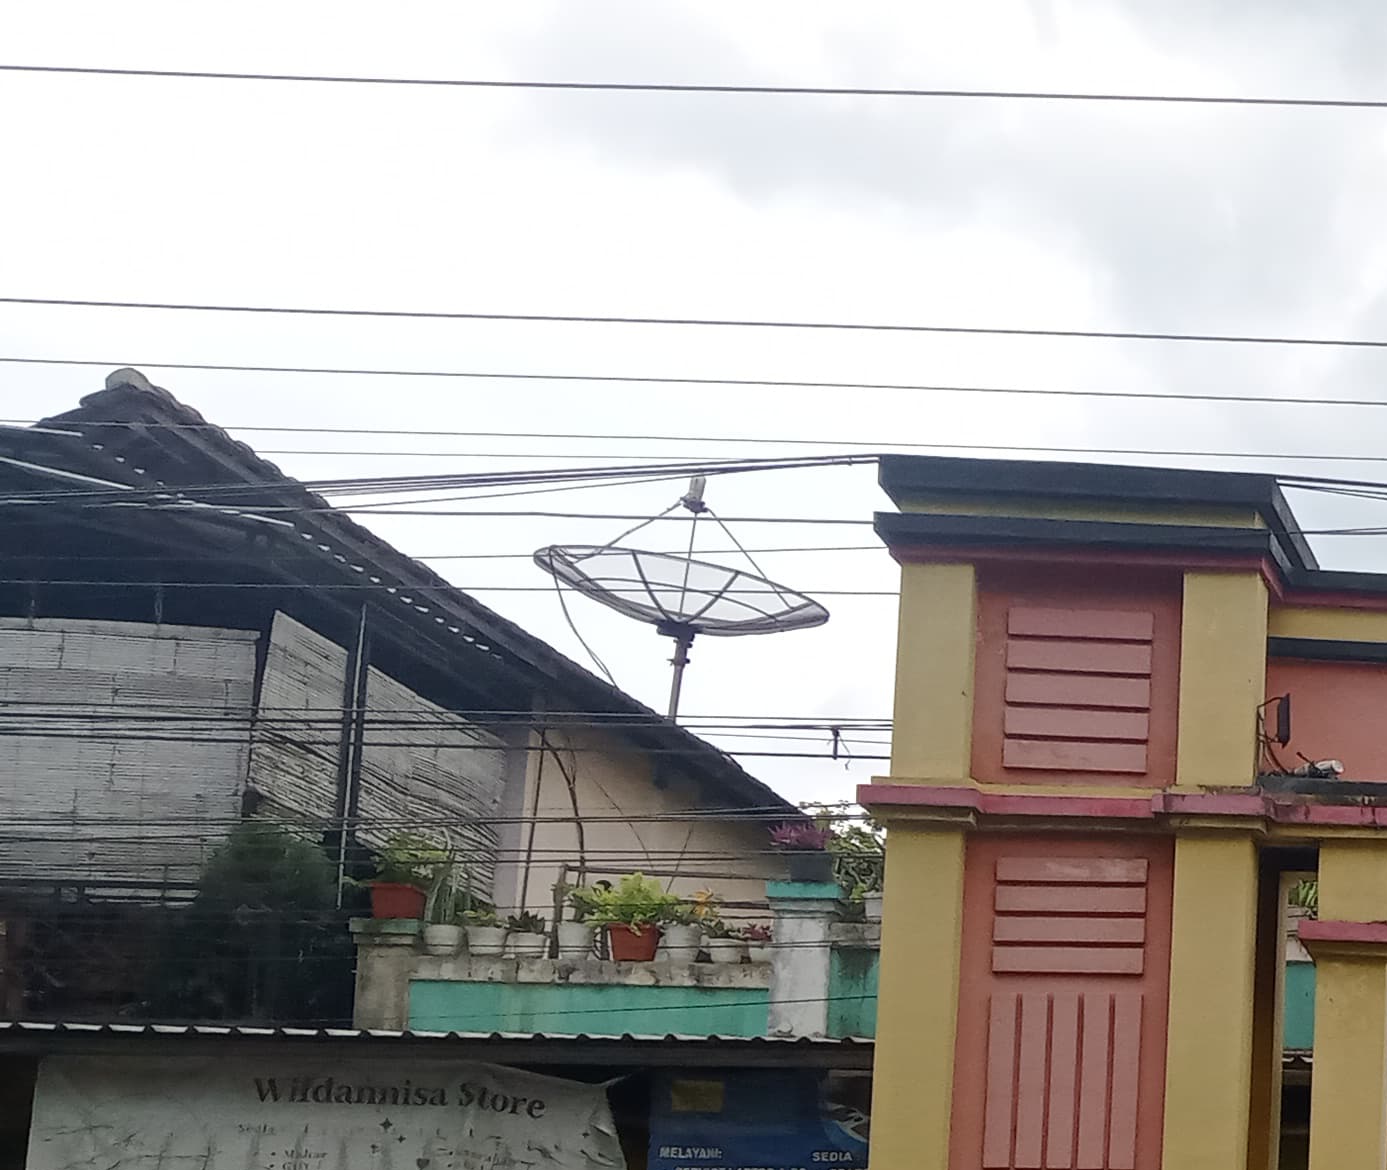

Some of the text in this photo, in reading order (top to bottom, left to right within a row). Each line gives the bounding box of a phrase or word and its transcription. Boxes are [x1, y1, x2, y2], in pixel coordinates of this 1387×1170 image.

[254, 1076, 546, 1119] Wildannisa Store
[812, 1151, 852, 1161] SEDIA
